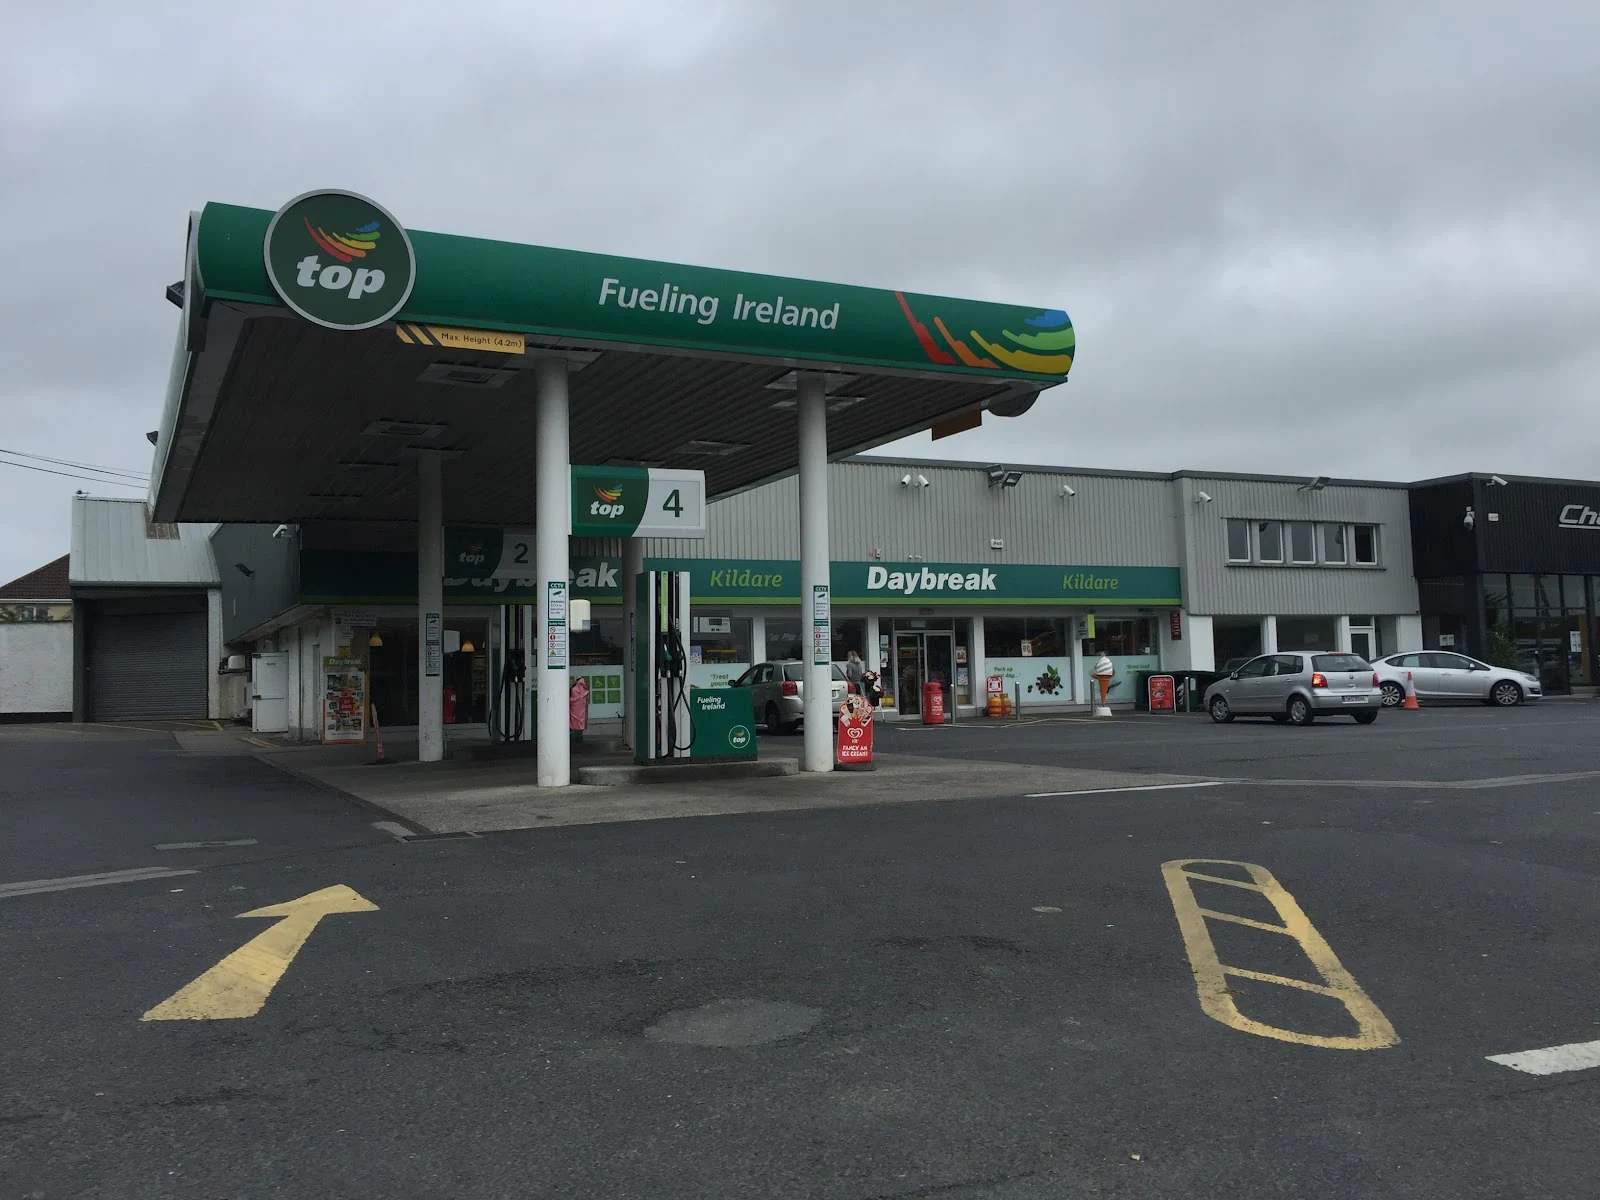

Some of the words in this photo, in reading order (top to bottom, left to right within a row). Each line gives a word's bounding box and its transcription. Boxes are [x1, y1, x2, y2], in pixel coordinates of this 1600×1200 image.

[296, 255, 386, 299] top
[598, 278, 719, 325] Fueling
[732, 293, 840, 330] Ireland
[441, 332, 461, 342] Max.
[463, 334, 491, 345] Height
[494, 337, 523, 348] (4.2m)
[590, 501, 625, 518] top
[662, 489, 684, 517] 4
[459, 551, 485, 566] top
[513, 542, 529, 564] 2
[710, 568, 783, 587] Kildare
[867, 566, 998, 595] Daybreak
[1062, 573, 1119, 590] Kildare
[329, 658, 362, 666] Daybreak
[697, 696, 721, 704] Fueling
[701, 702, 726, 711] Ireland
[733, 736, 746, 744] top
